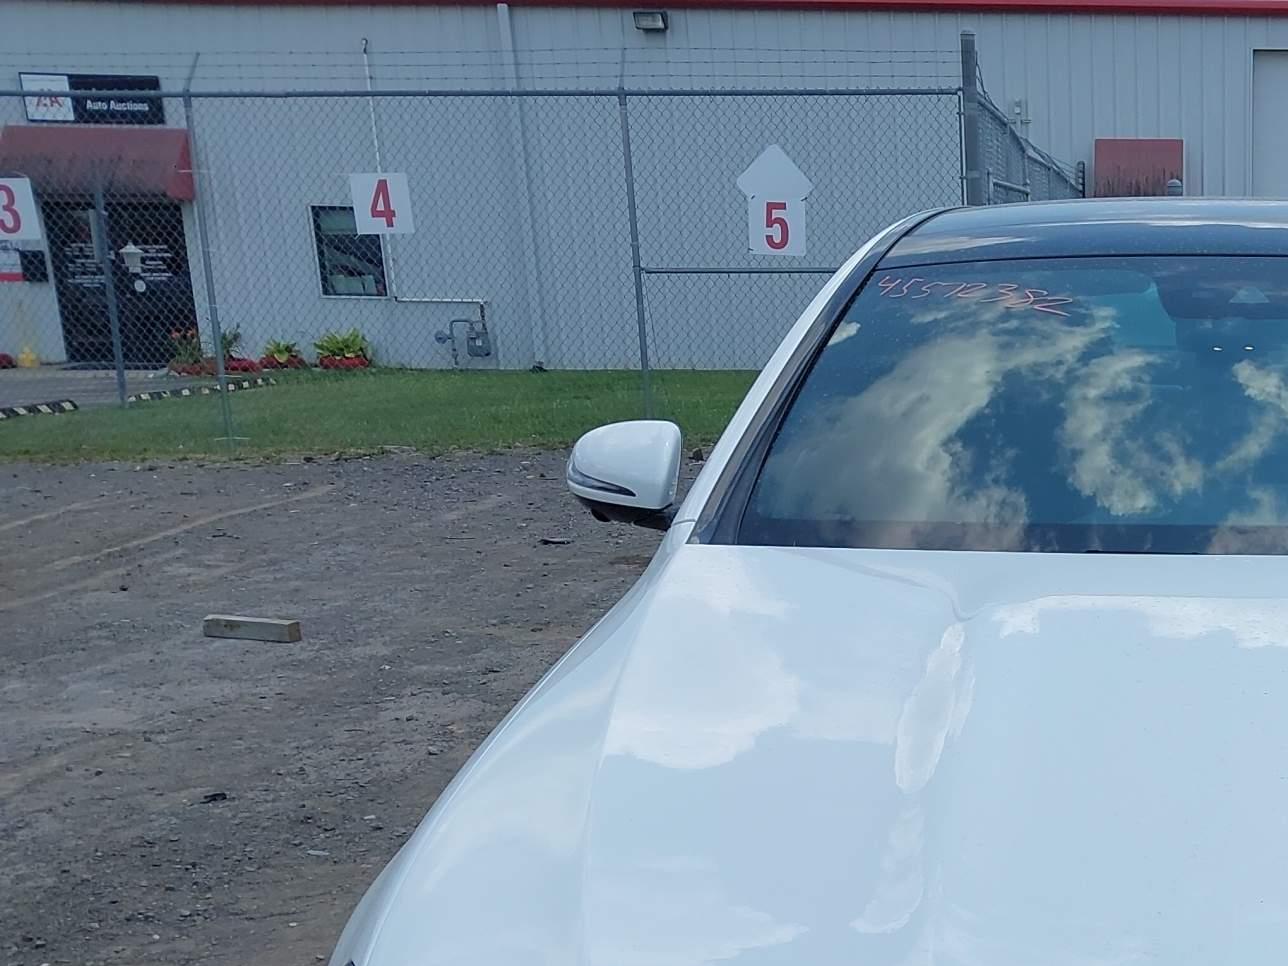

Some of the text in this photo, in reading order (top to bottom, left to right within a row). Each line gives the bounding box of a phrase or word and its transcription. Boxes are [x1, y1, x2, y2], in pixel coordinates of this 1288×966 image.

[86, 99, 149, 111] Auto Auctions
[0, 184, 21, 234] 3
[370, 178, 397, 228] 4
[765, 201, 789, 250] 5
[877, 275, 1073, 318] 45572382
